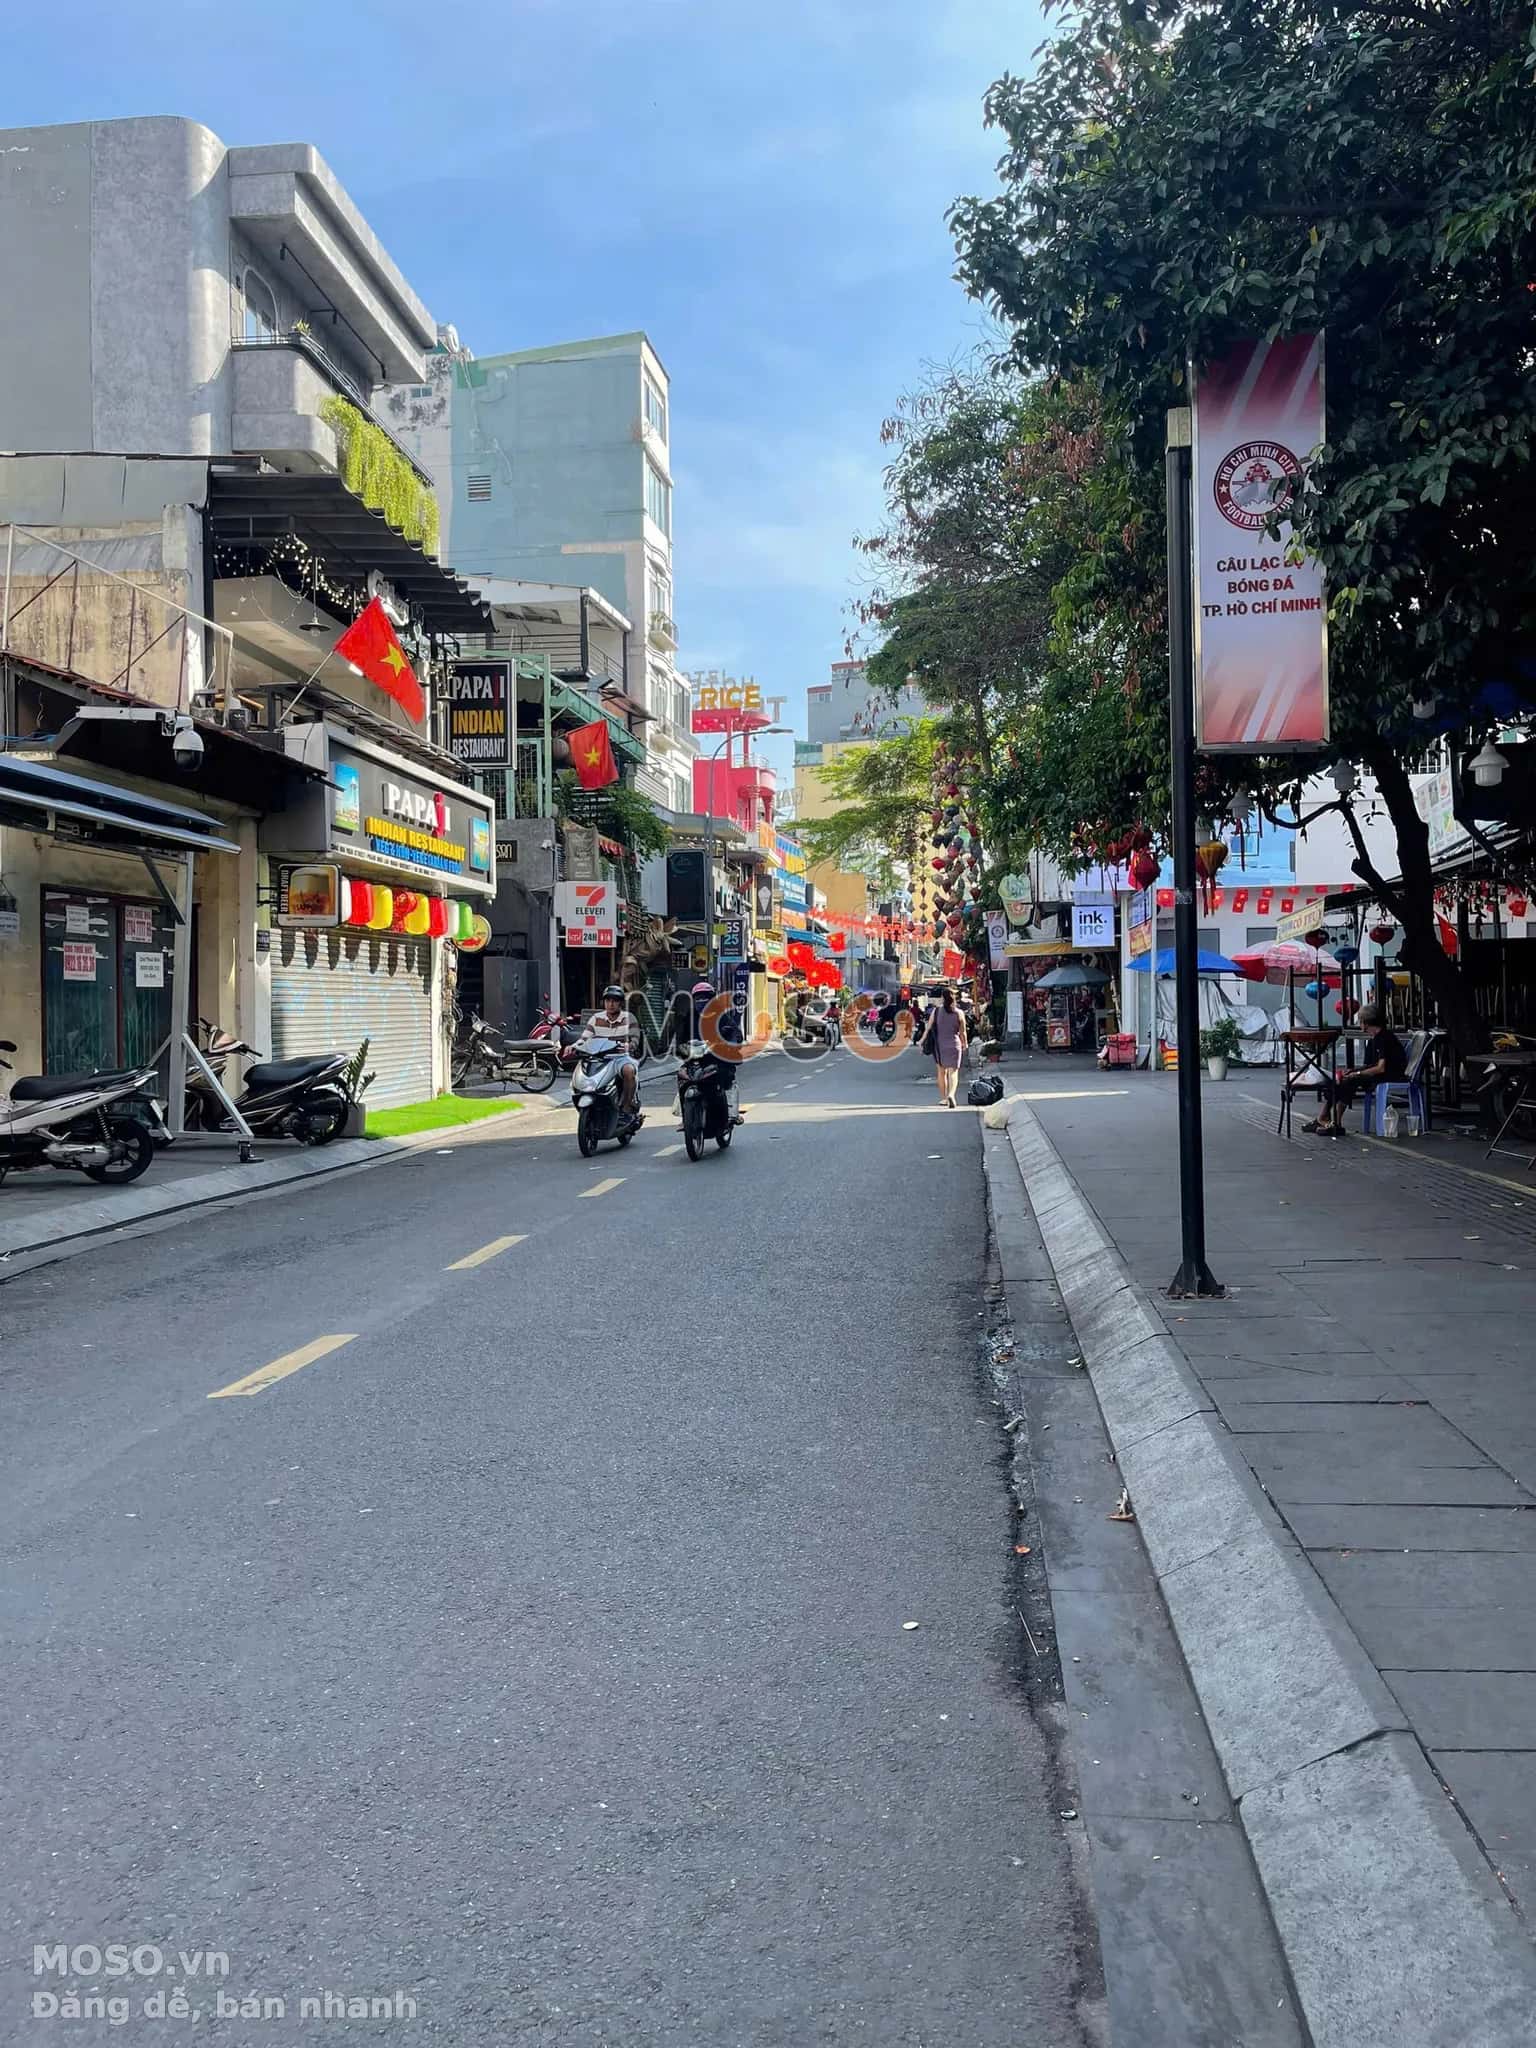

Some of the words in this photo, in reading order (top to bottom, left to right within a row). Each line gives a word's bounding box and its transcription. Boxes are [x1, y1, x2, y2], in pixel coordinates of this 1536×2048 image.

[1219, 467, 1234, 481] HO
[1230, 450, 1249, 467] CHI
[1249, 445, 1279, 458] MINH
[1278, 454, 1297, 475] CITY
[1222, 501, 1267, 526] FOOTBAL
[1216, 557, 1247, 572] CÂU
[1250, 556, 1281, 572] LẠC
[1228, 578, 1269, 593] BÓNG
[1272, 575, 1295, 590] ĐÁ
[1202, 604, 1223, 617] TP.
[1226, 599, 1248, 616] HỒ
[1251, 598, 1278, 614] CHÍ
[1280, 597, 1321, 613] MINH
[699, 684, 761, 710] RICE
[453, 709, 505, 735] INDIAN
[452, 738, 505, 758] RESTAURANT
[366, 816, 407, 845] INDIAN
[408, 830, 466, 862] RESTAURANT
[1079, 910, 1107, 924] ink.
[723, 933, 740, 946] 25
